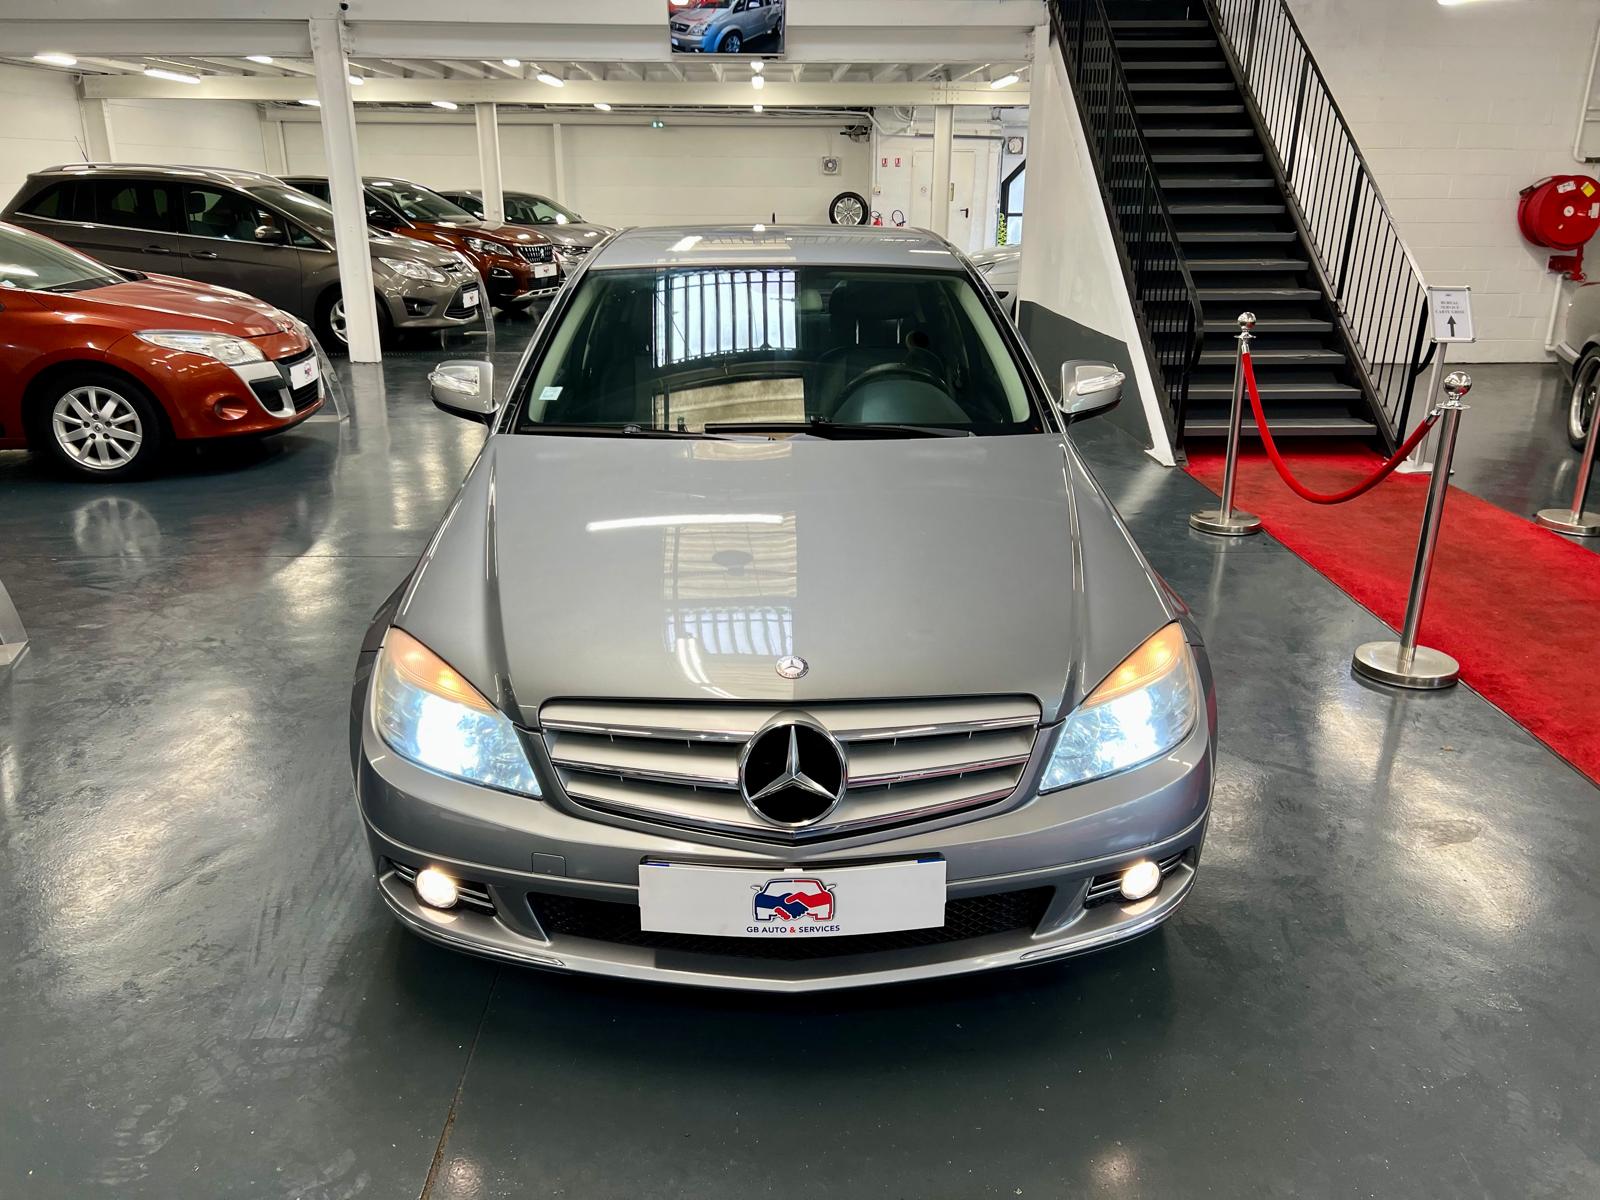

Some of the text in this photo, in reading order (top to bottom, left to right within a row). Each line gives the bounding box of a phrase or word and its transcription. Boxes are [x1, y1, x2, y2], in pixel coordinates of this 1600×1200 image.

[761, 926, 787, 934] AUTO
[789, 926, 797, 934] &
[798, 925, 840, 933] SERVICES
